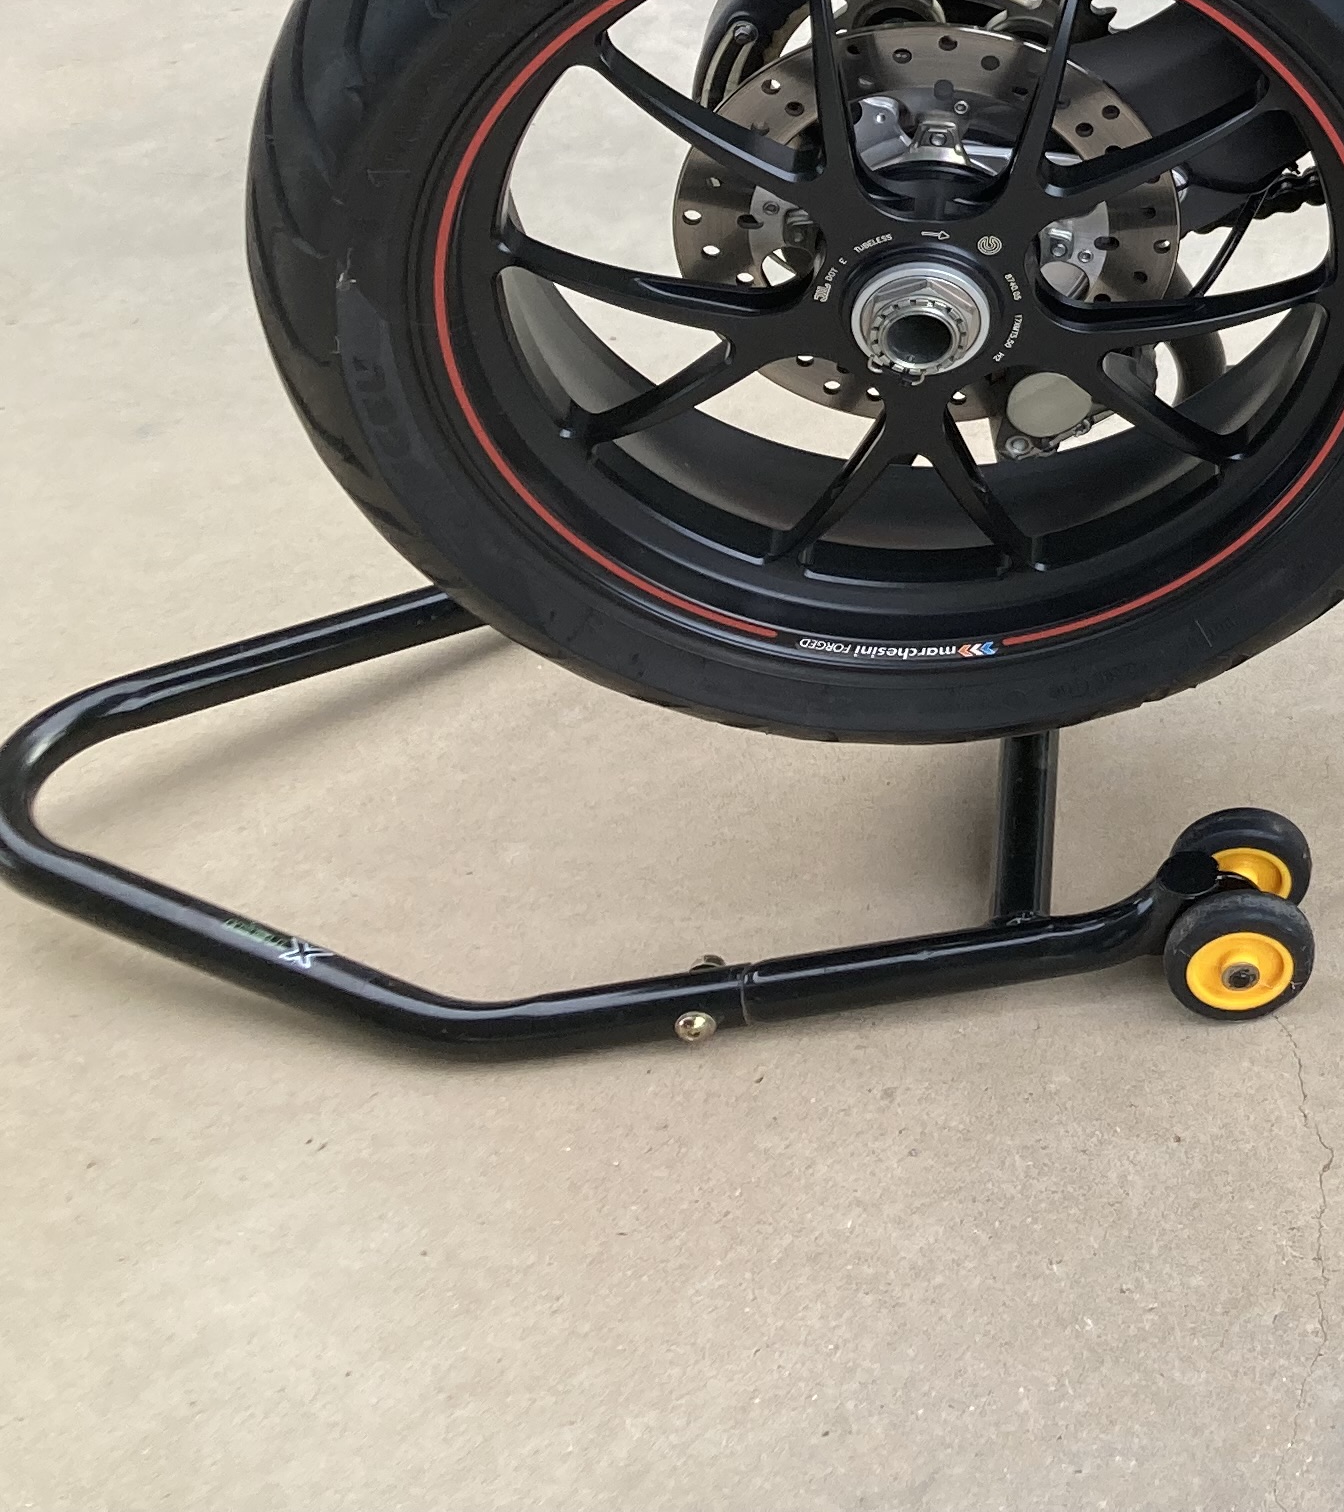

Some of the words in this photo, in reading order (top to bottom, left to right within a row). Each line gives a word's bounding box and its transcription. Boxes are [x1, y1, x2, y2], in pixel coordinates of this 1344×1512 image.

[853, 233, 893, 253] TUBELESS
[824, 267, 839, 282] DOT
[799, 638, 852, 654] FORGED
[853, 644, 957, 660] marchesini
